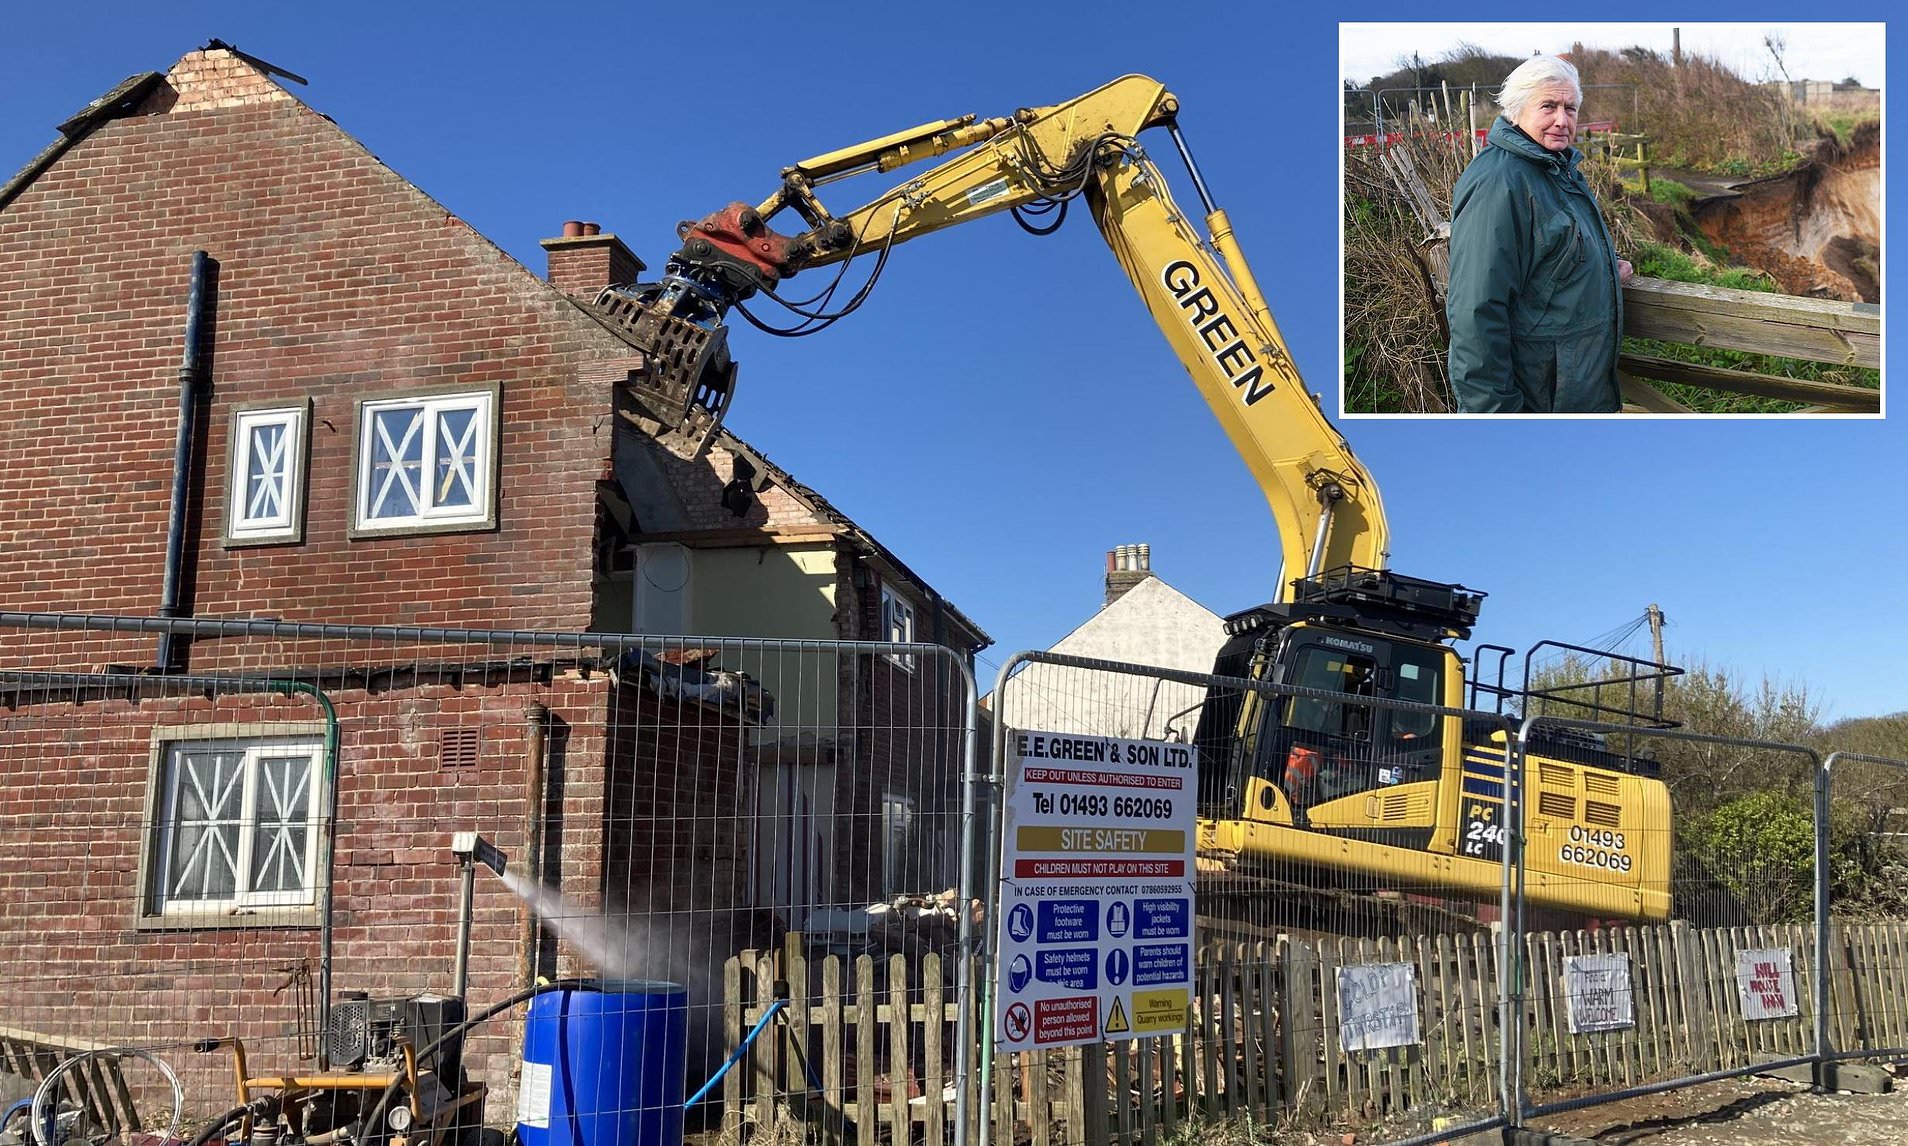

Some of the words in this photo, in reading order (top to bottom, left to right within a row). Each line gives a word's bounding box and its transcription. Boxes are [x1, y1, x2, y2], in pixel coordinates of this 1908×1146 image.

[1162, 260, 1276, 407] GREEN
[1326, 636, 1373, 653] KOMATSU
[1110, 743, 1120, 763] &
[1127, 744, 1159, 766] SON
[1164, 747, 1192, 768] LTD.
[1026, 768, 1047, 780] KEEP
[1049, 769, 1066, 781] OUT
[1067, 771, 1097, 783] UNLESS
[1098, 773, 1145, 786] AUTHORISED
[1147, 776, 1156, 787] TO
[1158, 777, 1181, 788] ENTER
[1033, 792, 1054, 814] Tel
[1060, 794, 1108, 816] 01493
[1114, 797, 1172, 819] 662069
[1469, 804, 1493, 821] PC
[1061, 829, 1091, 850] SITE
[1095, 830, 1147, 850] SAFETY
[1569, 825, 1625, 850] 01493
[1466, 841, 1484, 855] LC
[1561, 845, 1632, 871] 662069
[1034, 863, 1071, 874] CHILDREN
[1072, 863, 1091, 874] MUST
[1093, 863, 1108, 874] NOT
[1109, 863, 1126, 874] PLAY
[1127, 863, 1138, 874] ON
[1139, 863, 1154, 874] THIS
[1155, 864, 1169, 874] SITE
[1014, 886, 1023, 896] IN
[1025, 886, 1045, 896] CASE
[1047, 886, 1057, 896] OF
[1058, 886, 1104, 896] EMERGENCY
[1105, 885, 1138, 895] CONTACT
[1053, 904, 1085, 914] Protective
[1142, 902, 1156, 914] High
[1157, 902, 1180, 912] visibility
[1151, 914, 1171, 926] jackets
[1046, 930, 1063, 940] must
[1064, 930, 1072, 938] be
[1073, 930, 1089, 938] worn
[1142, 927, 1156, 936] must
[1158, 926, 1165, 935] be
[1140, 946, 1161, 957] Parents
[1162, 946, 1181, 955] should
[1044, 953, 1065, 965] Safety
[1066, 952, 1090, 962] helmets
[1154, 958, 1176, 968] children
[1176, 957, 1183, 966] of
[1046, 966, 1062, 976] must
[1063, 966, 1071, 976] be
[1072, 966, 1088, 974] worn
[1136, 971, 1162, 984] potential
[1162, 970, 1184, 980] hazards
[1070, 978, 1084, 987] area
[1581, 987, 1614, 1005] WARM
[1040, 1002, 1050, 1012] No
[1051, 999, 1092, 1010] unauthorised
[1149, 1000, 1172, 1008] Warning
[1042, 1016, 1065, 1028] person
[1066, 1012, 1090, 1023] allowed
[1137, 1014, 1157, 1025] Quarry
[1158, 1014, 1184, 1024] workings
[1578, 1007, 1618, 1023] WELCOME
[1040, 1028, 1063, 1040] beyond
[1064, 1026, 1076, 1036] this
[1076, 1025, 1092, 1037] point
